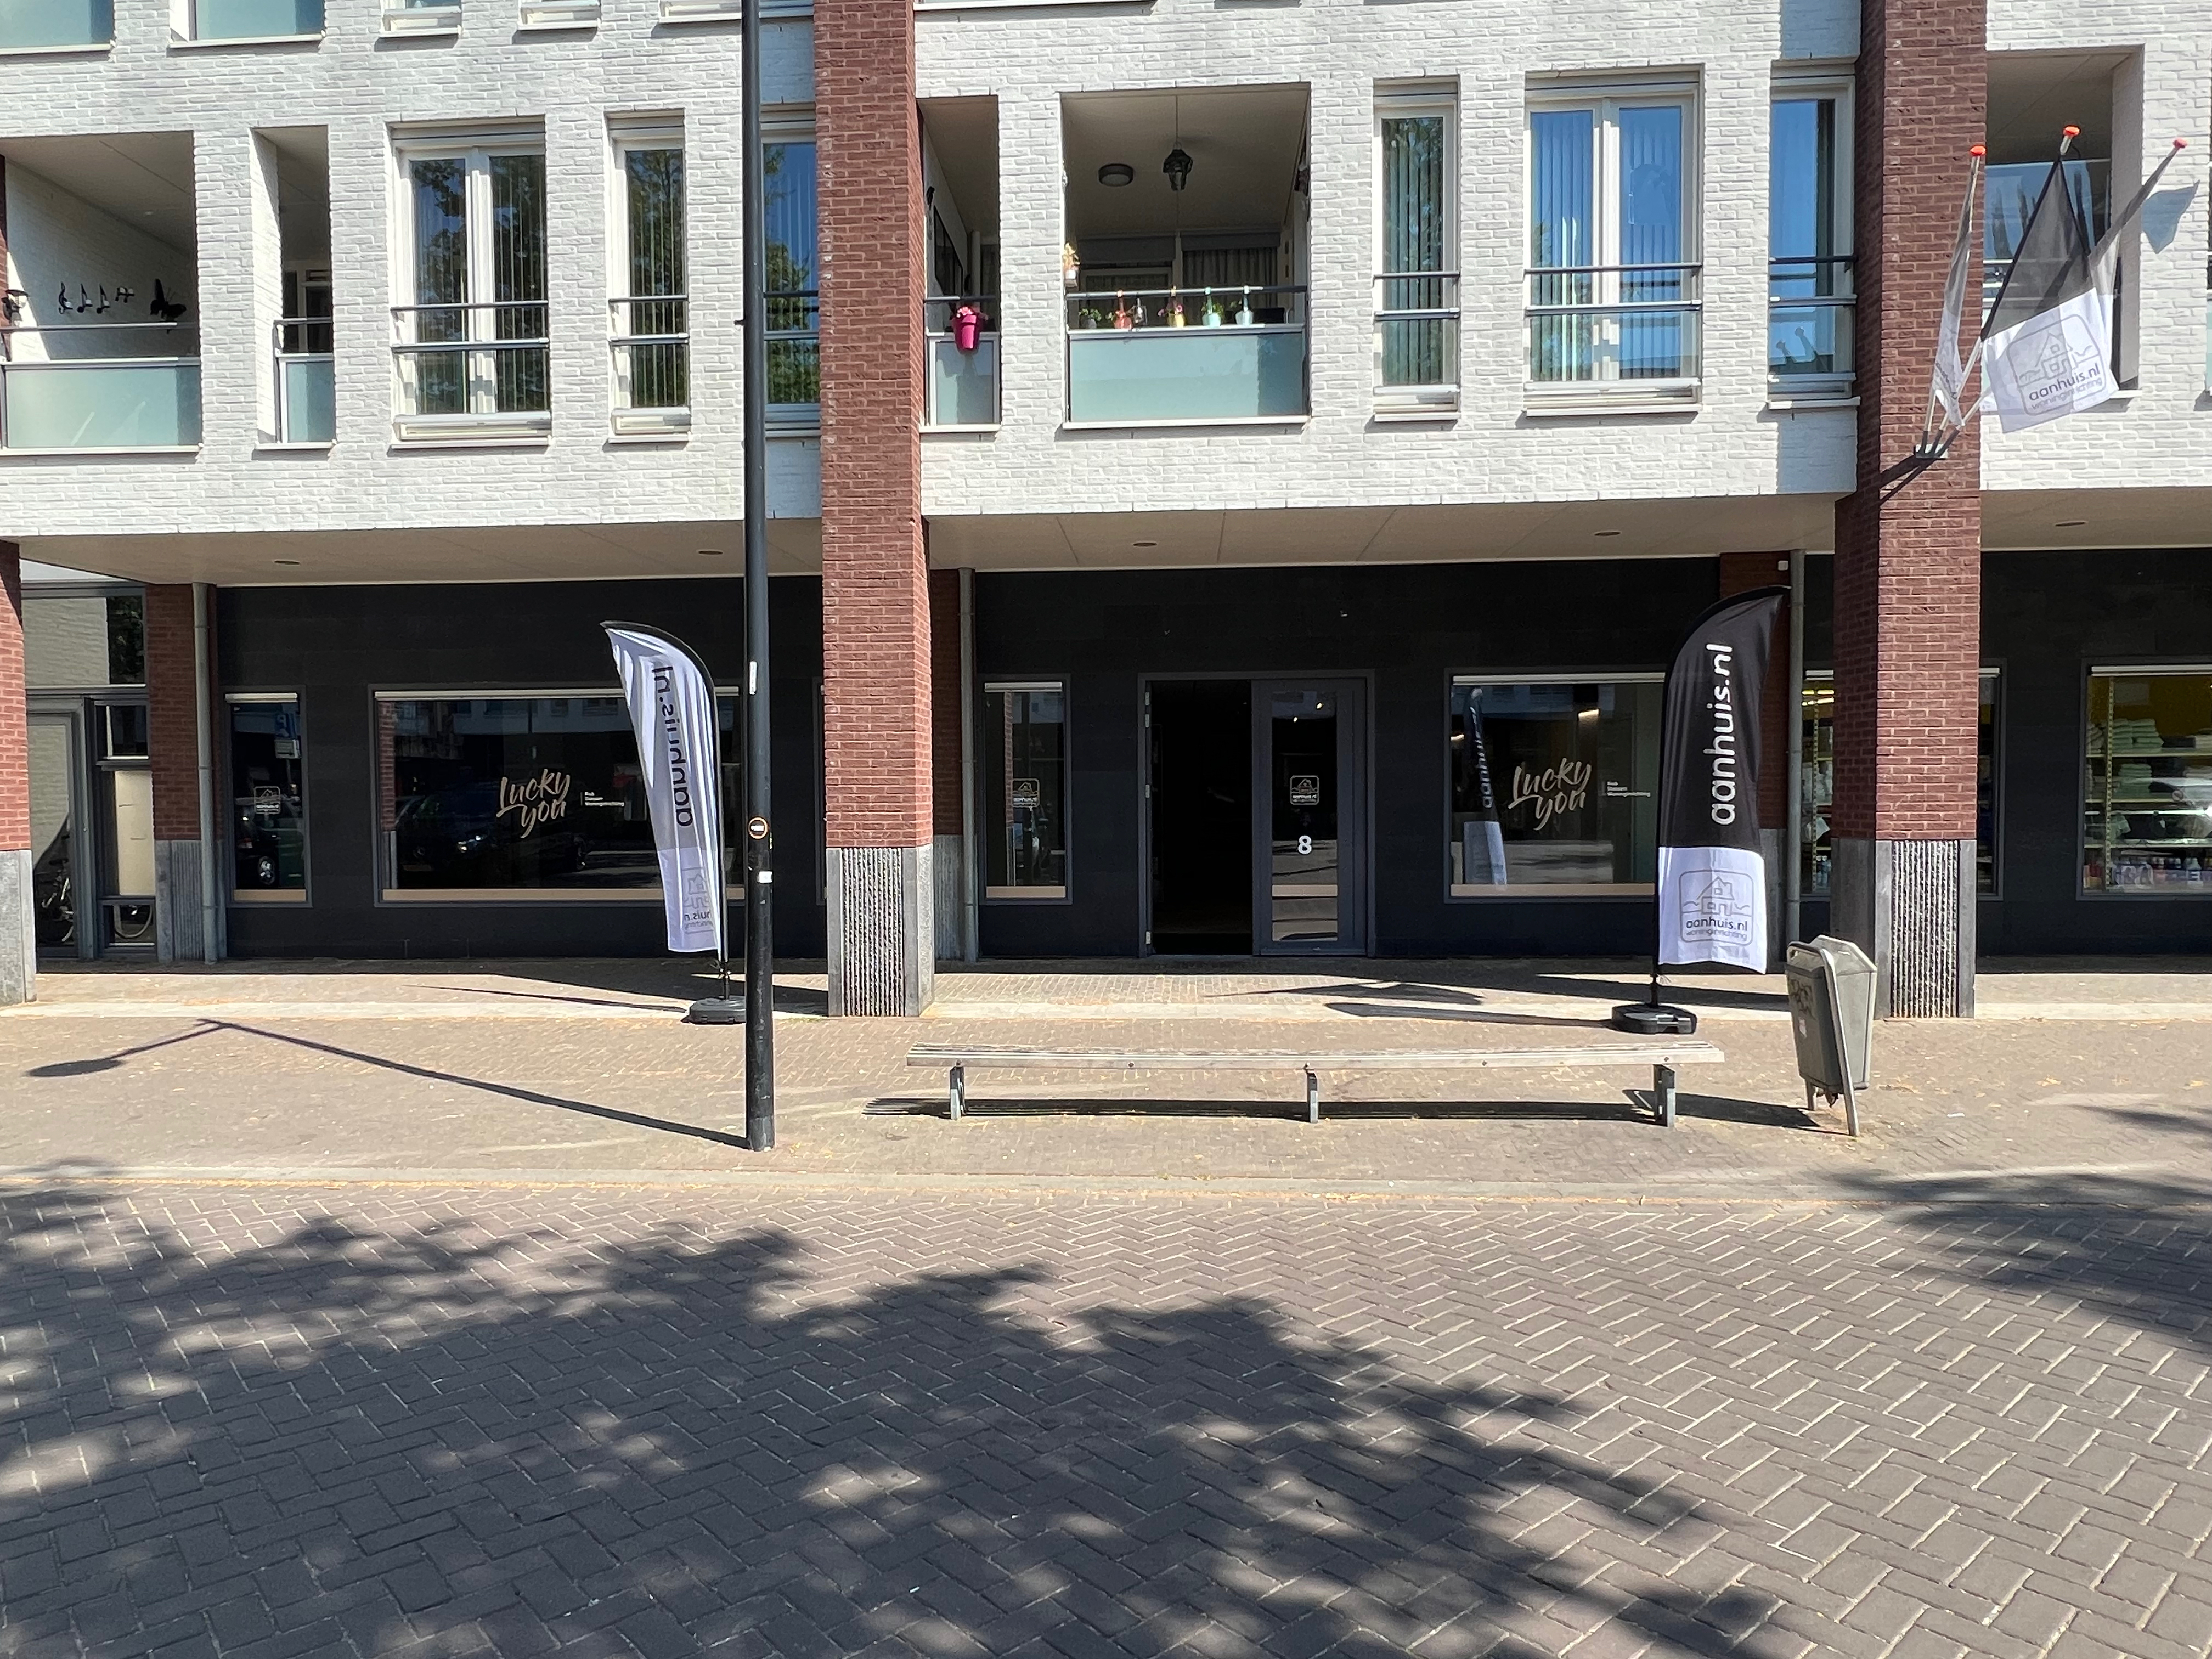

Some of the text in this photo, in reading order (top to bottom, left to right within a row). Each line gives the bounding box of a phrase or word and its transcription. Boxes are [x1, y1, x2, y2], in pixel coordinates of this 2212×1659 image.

[2029, 362, 2101, 401] aanhuis.nl
[1703, 643, 1736, 825] aanhuis.nl
[496, 768, 571, 817] Lucky
[1508, 757, 1592, 809] Lucky
[520, 799, 566, 838] you
[1533, 790, 1585, 831] you
[1297, 835, 1312, 855] 8
[1685, 916, 1748, 932] aanhuis.nl
